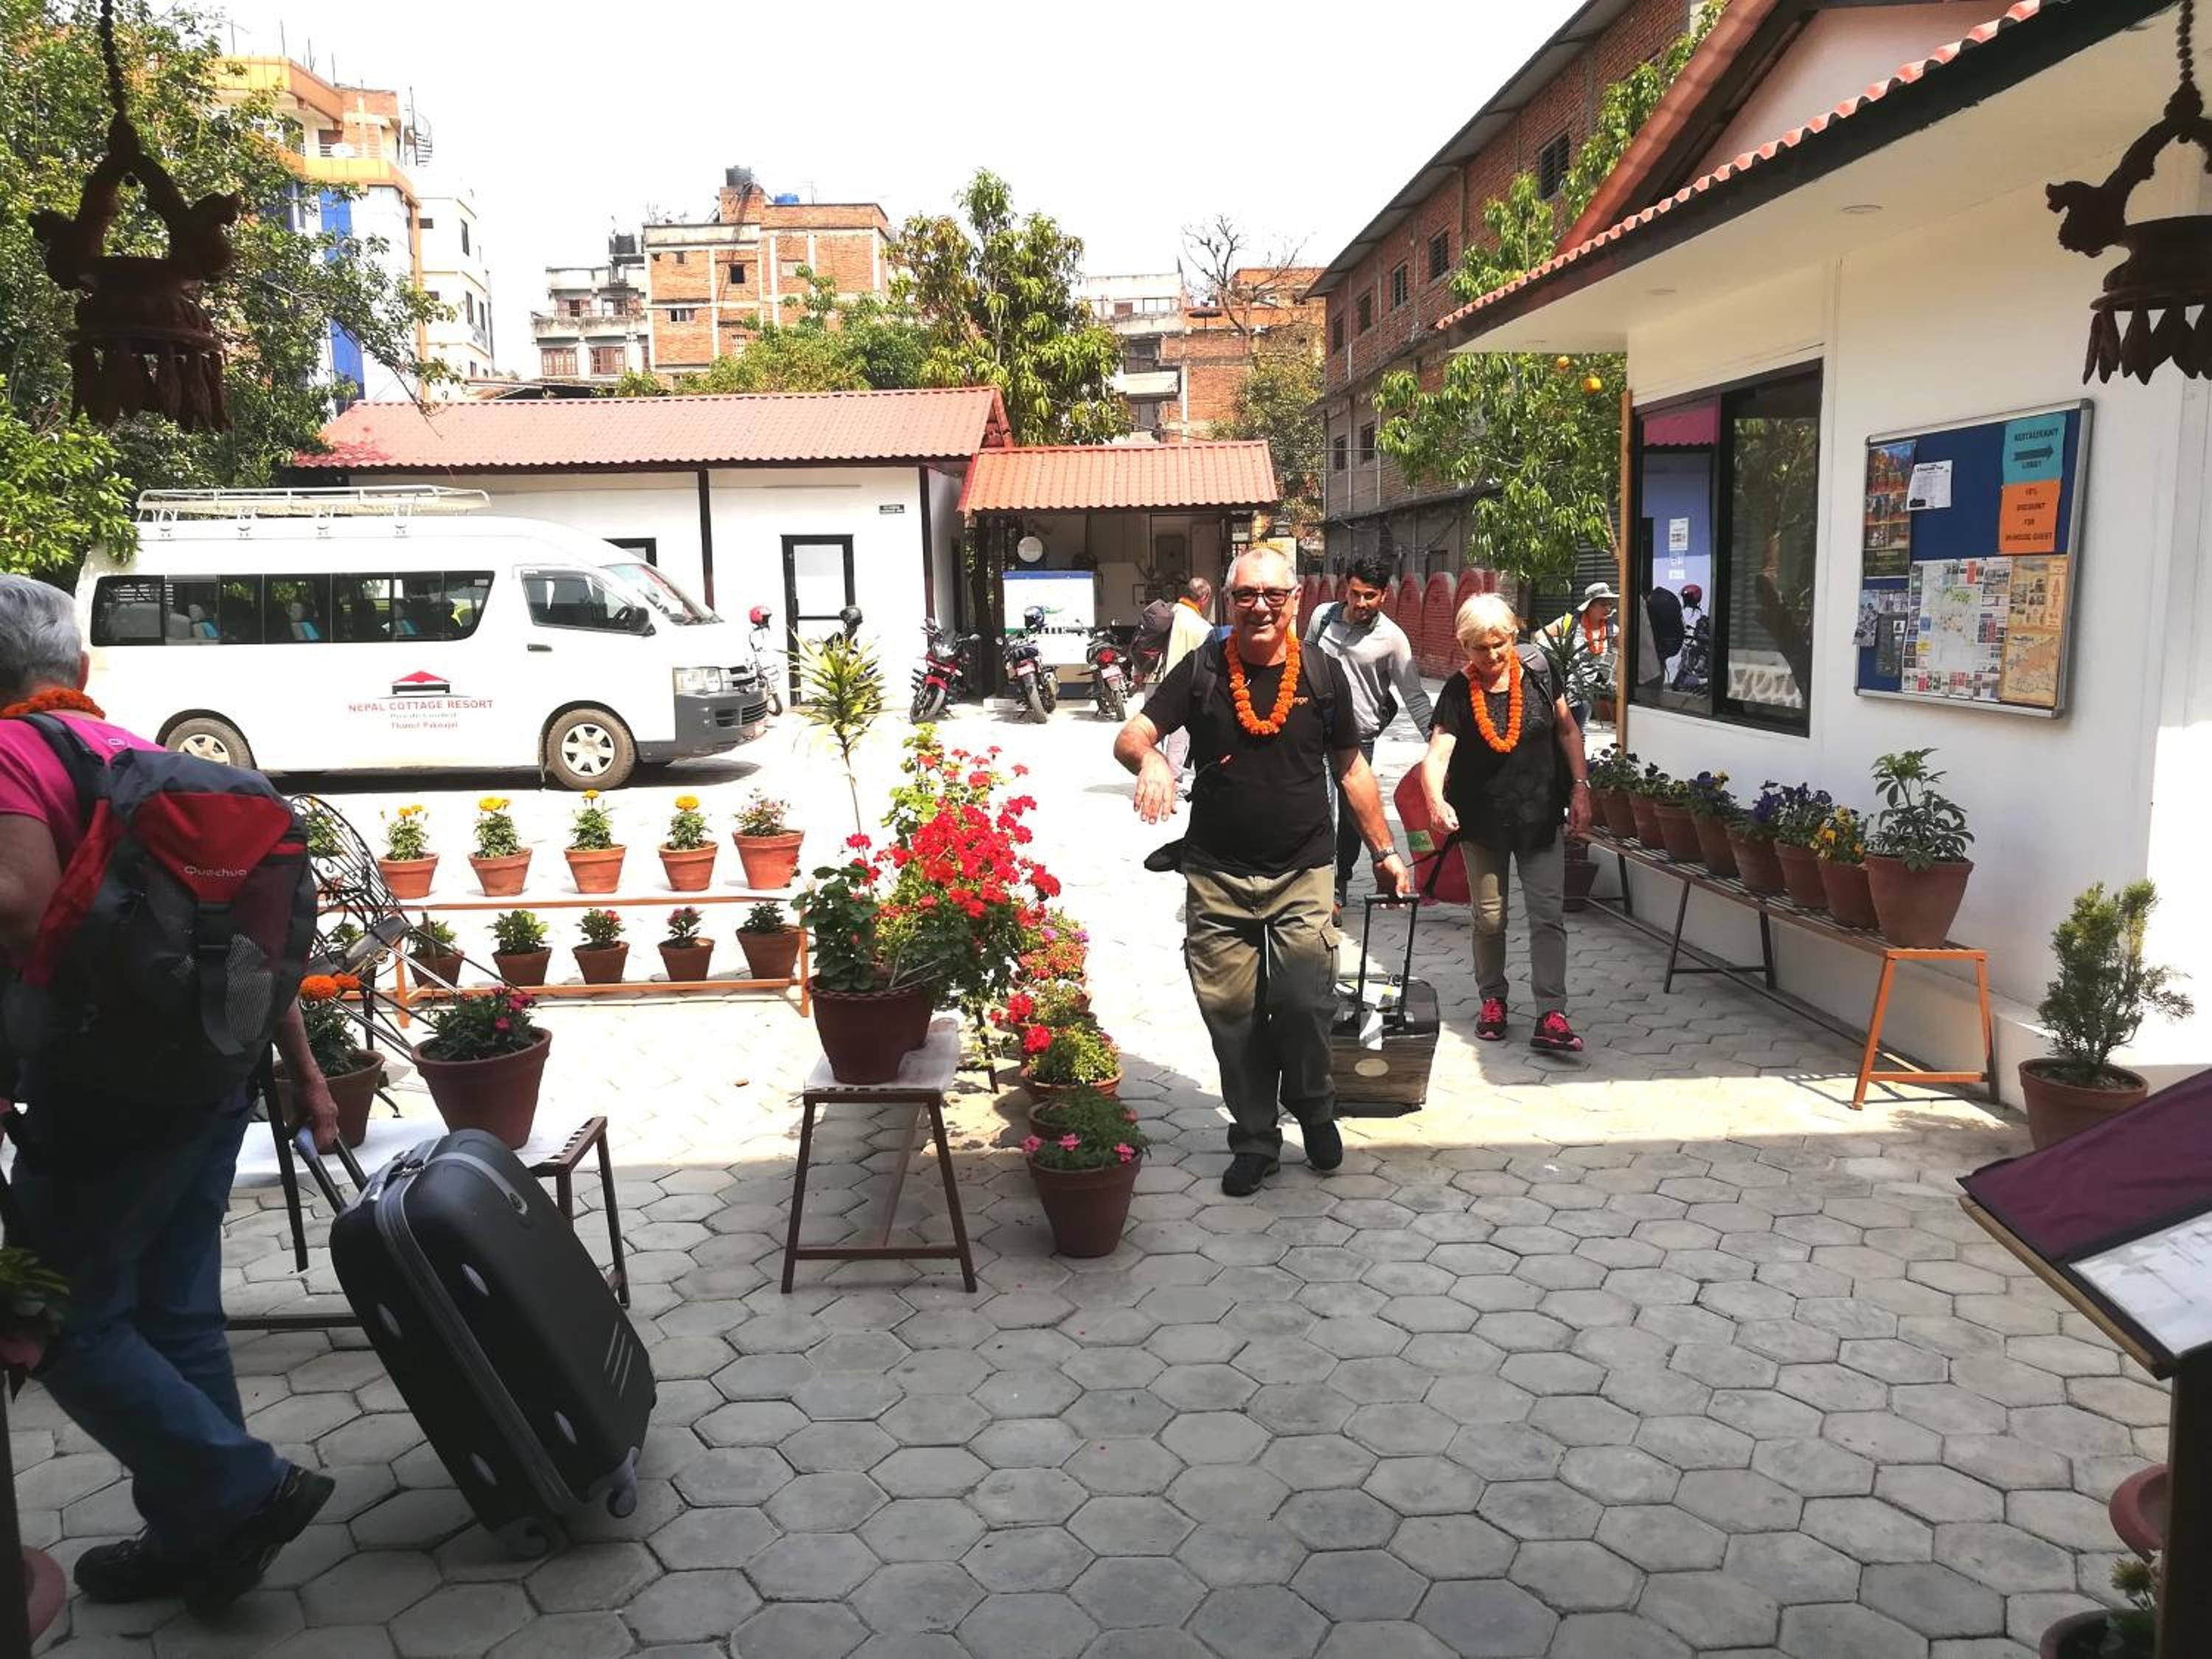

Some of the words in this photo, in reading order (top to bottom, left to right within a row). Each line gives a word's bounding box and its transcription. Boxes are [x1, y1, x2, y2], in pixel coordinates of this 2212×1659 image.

[348, 703, 385, 712] NEPAL
[389, 700, 443, 711] COTTAGE
[448, 699, 494, 709] RESORT
[184, 866, 248, 877] Quechua
